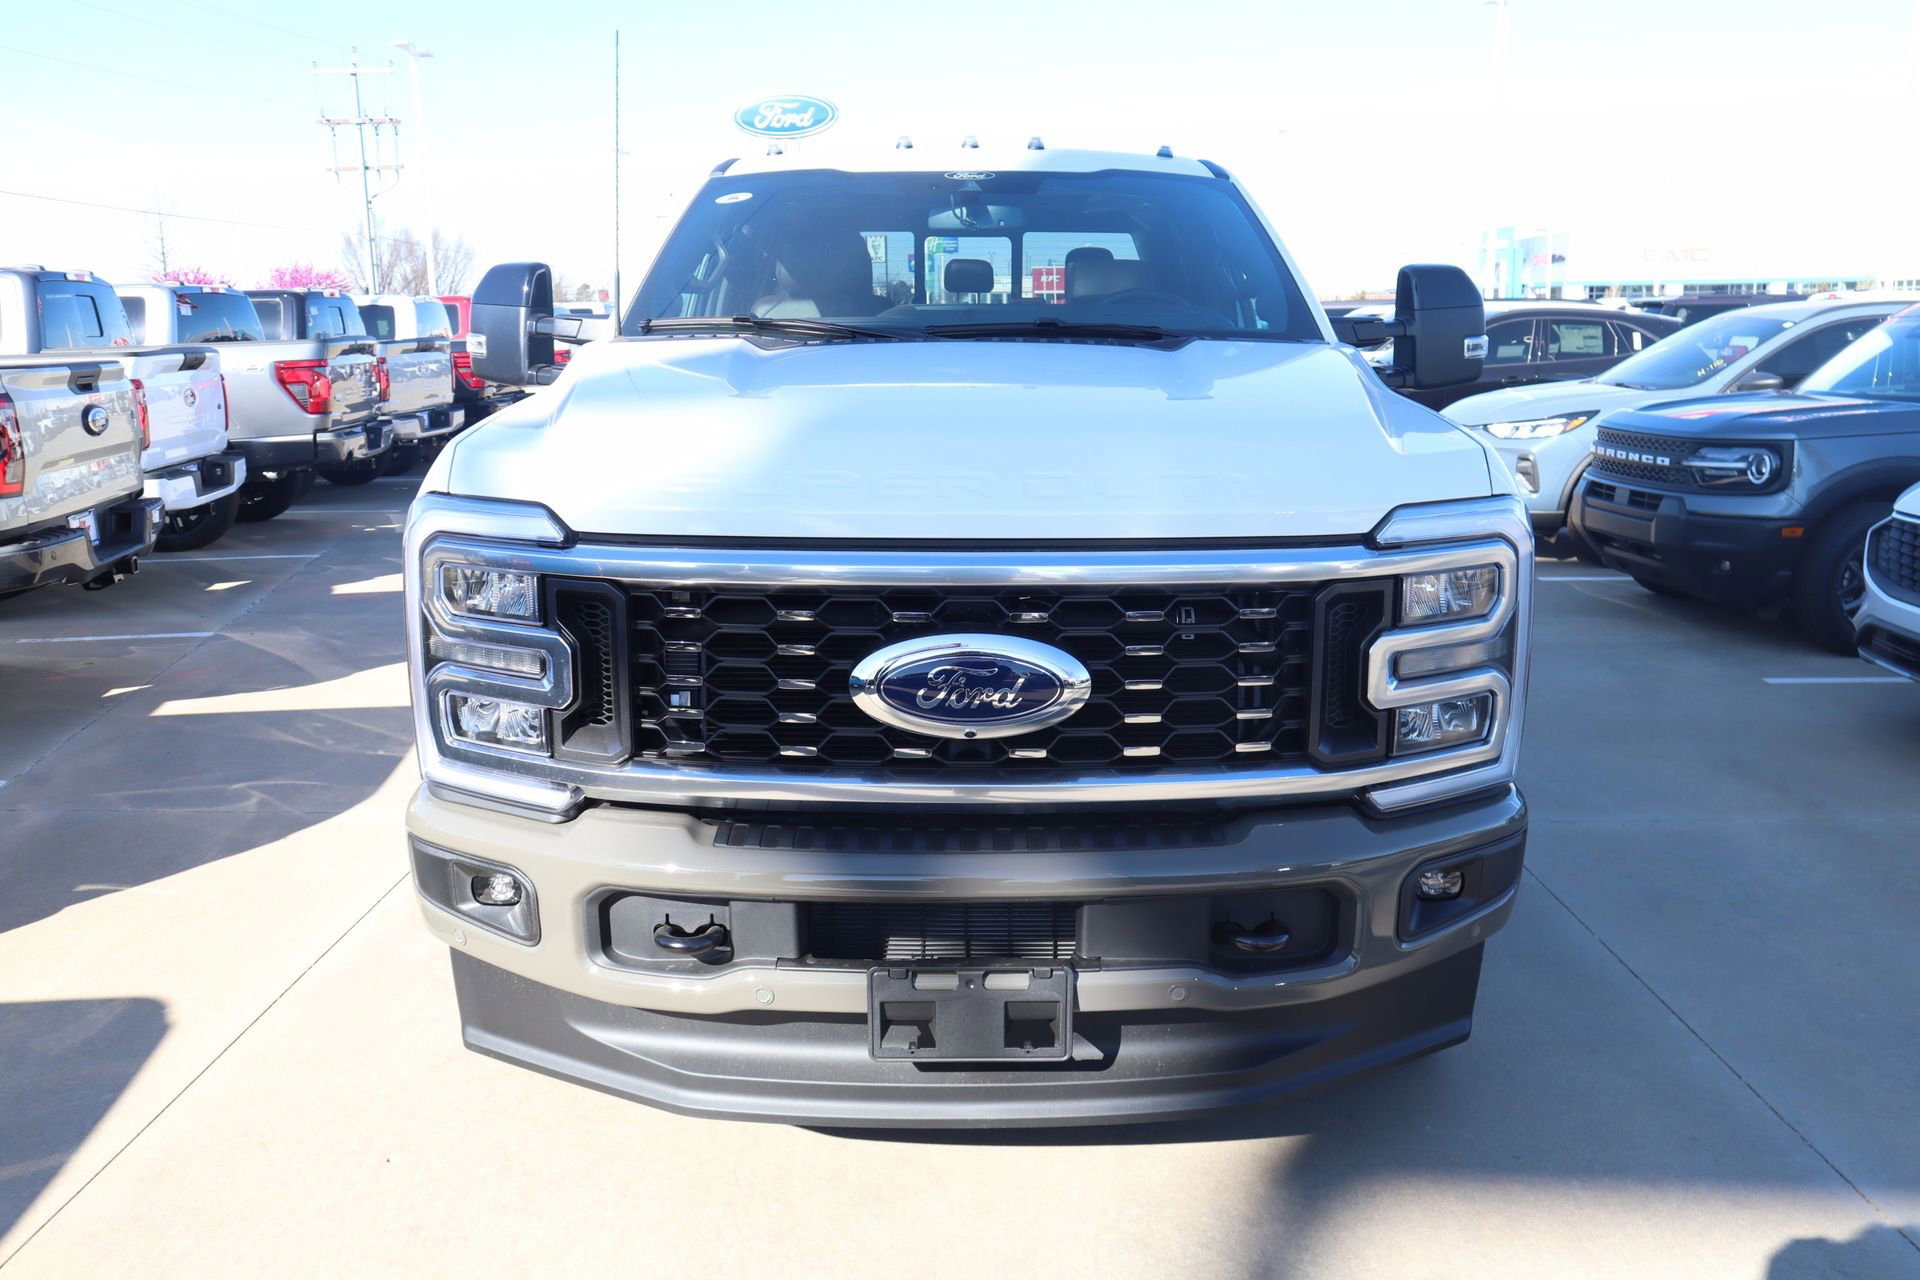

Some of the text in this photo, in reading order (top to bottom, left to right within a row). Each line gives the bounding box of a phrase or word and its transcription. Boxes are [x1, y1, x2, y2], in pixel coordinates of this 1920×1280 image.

[754, 102, 815, 128] Ford
[1597, 446, 1670, 466] BRONCO
[916, 665, 1025, 709] Ford
